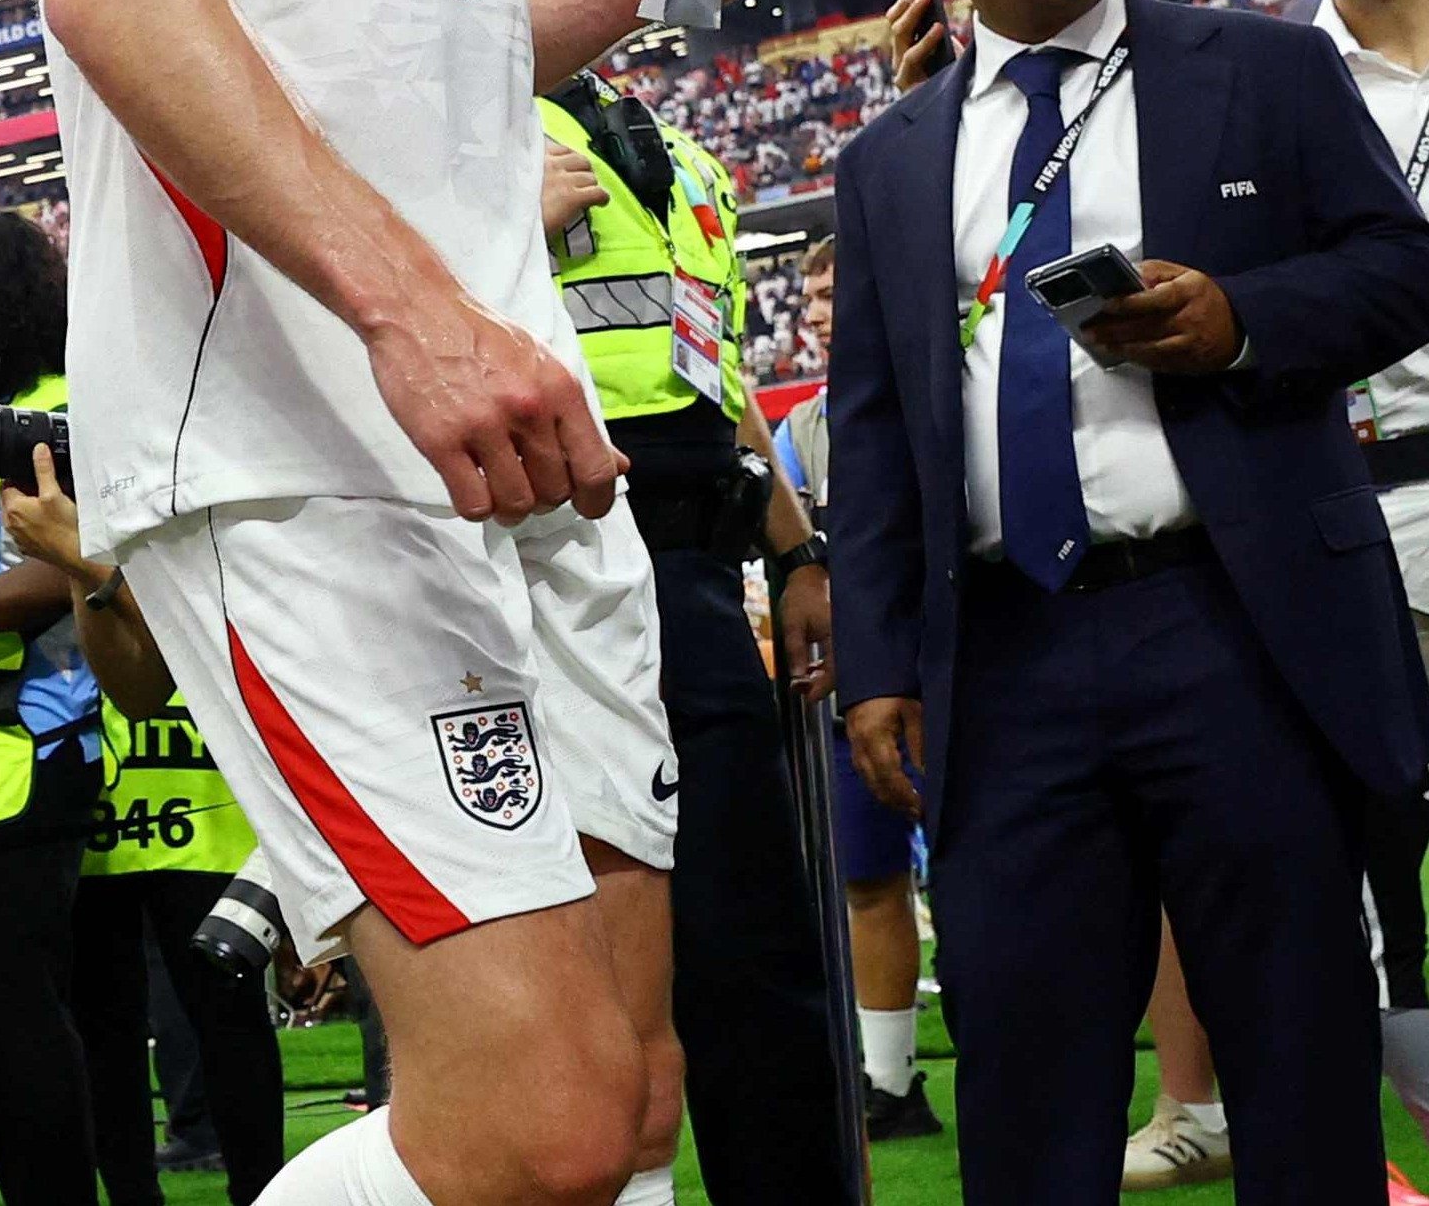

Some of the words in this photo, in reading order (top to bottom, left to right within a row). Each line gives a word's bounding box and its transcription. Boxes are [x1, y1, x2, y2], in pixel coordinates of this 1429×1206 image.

[1034, 159, 1062, 192] FIFA
[1097, 47, 1130, 88] 2026
[1221, 180, 1258, 198] FIFA
